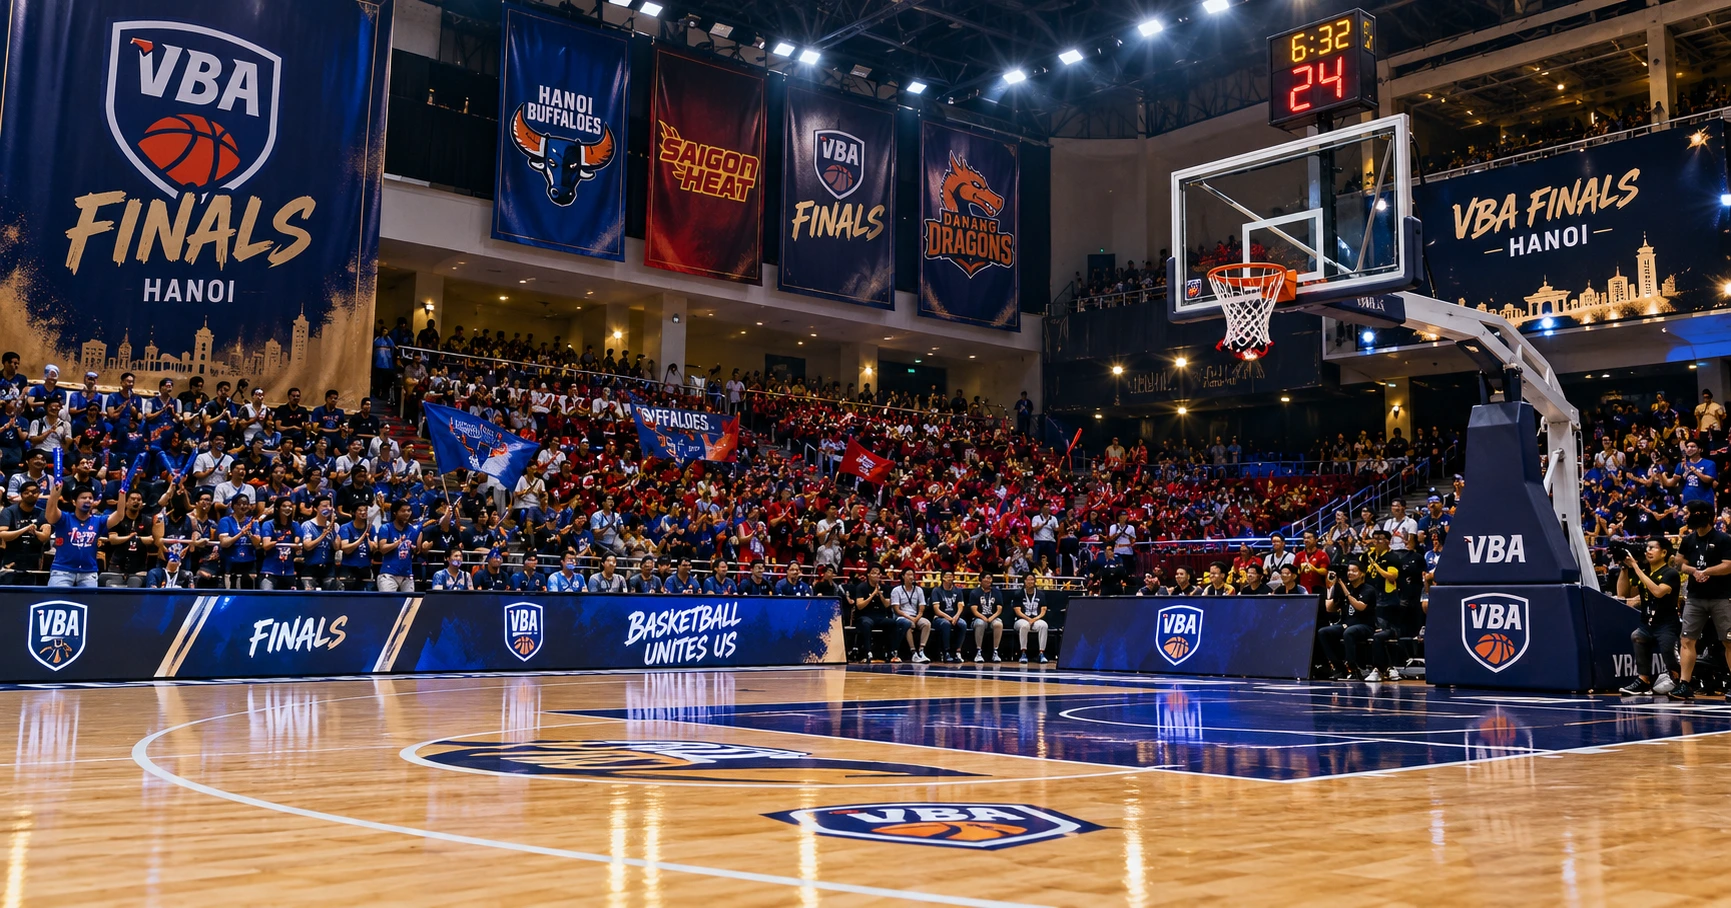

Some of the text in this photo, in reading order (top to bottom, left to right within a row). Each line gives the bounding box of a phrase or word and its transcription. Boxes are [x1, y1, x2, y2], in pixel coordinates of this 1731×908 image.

[1291, 19, 1350, 62] 6:32
[130, 37, 260, 117] VBA
[1289, 56, 1343, 112] 24
[538, 85, 593, 115] HANOI
[527, 102, 601, 135] BUFFALOES
[659, 136, 759, 180] SAIGON
[820, 136, 859, 166] VBA
[680, 168, 754, 202] HEAT
[1452, 167, 1641, 240] VBA FINALS
[64, 190, 317, 276] FINALS
[791, 200, 886, 242] FINALS
[943, 211, 997, 234] DANANG
[927, 221, 1014, 266] DRAGONS
[1509, 223, 1588, 258] HANOI
[143, 278, 236, 303] HANOI
[1463, 534, 1526, 563] VBA
[37, 609, 79, 637] VBA
[509, 609, 538, 632] VBA
[624, 601, 742, 647] BASKETBALL
[1163, 613, 1196, 635] VBA
[1467, 603, 1522, 630] VBA
[249, 615, 348, 658] FINALS
[644, 631, 738, 666] UNITES US
[828, 807, 1027, 824] VBA
